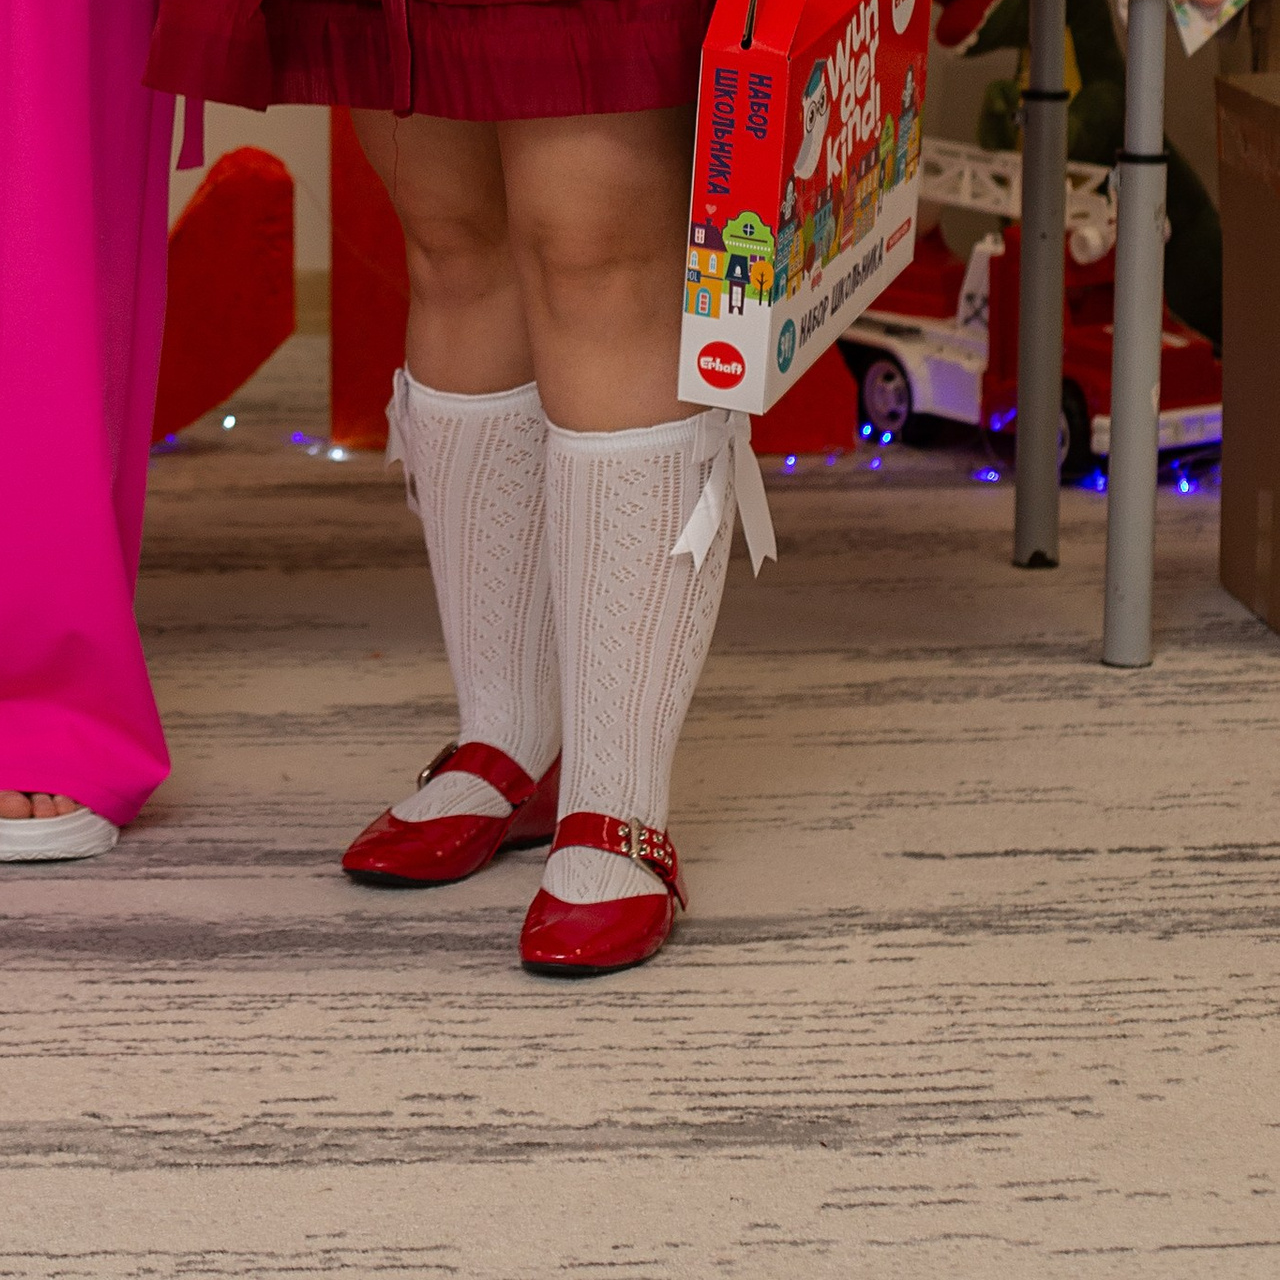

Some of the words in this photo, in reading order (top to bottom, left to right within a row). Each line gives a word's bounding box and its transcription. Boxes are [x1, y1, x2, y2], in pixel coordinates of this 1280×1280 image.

[745, 71, 773, 140] НАБОР
[840, 29, 880, 124] der
[707, 67, 739, 195] ШКОЛЬНИКА
[826, 77, 882, 187] kind!
[799, 295, 829, 349] НАБОР
[830, 236, 884, 317] ШКОЛЬНИКА
[700, 356, 743, 376] Erhaft
